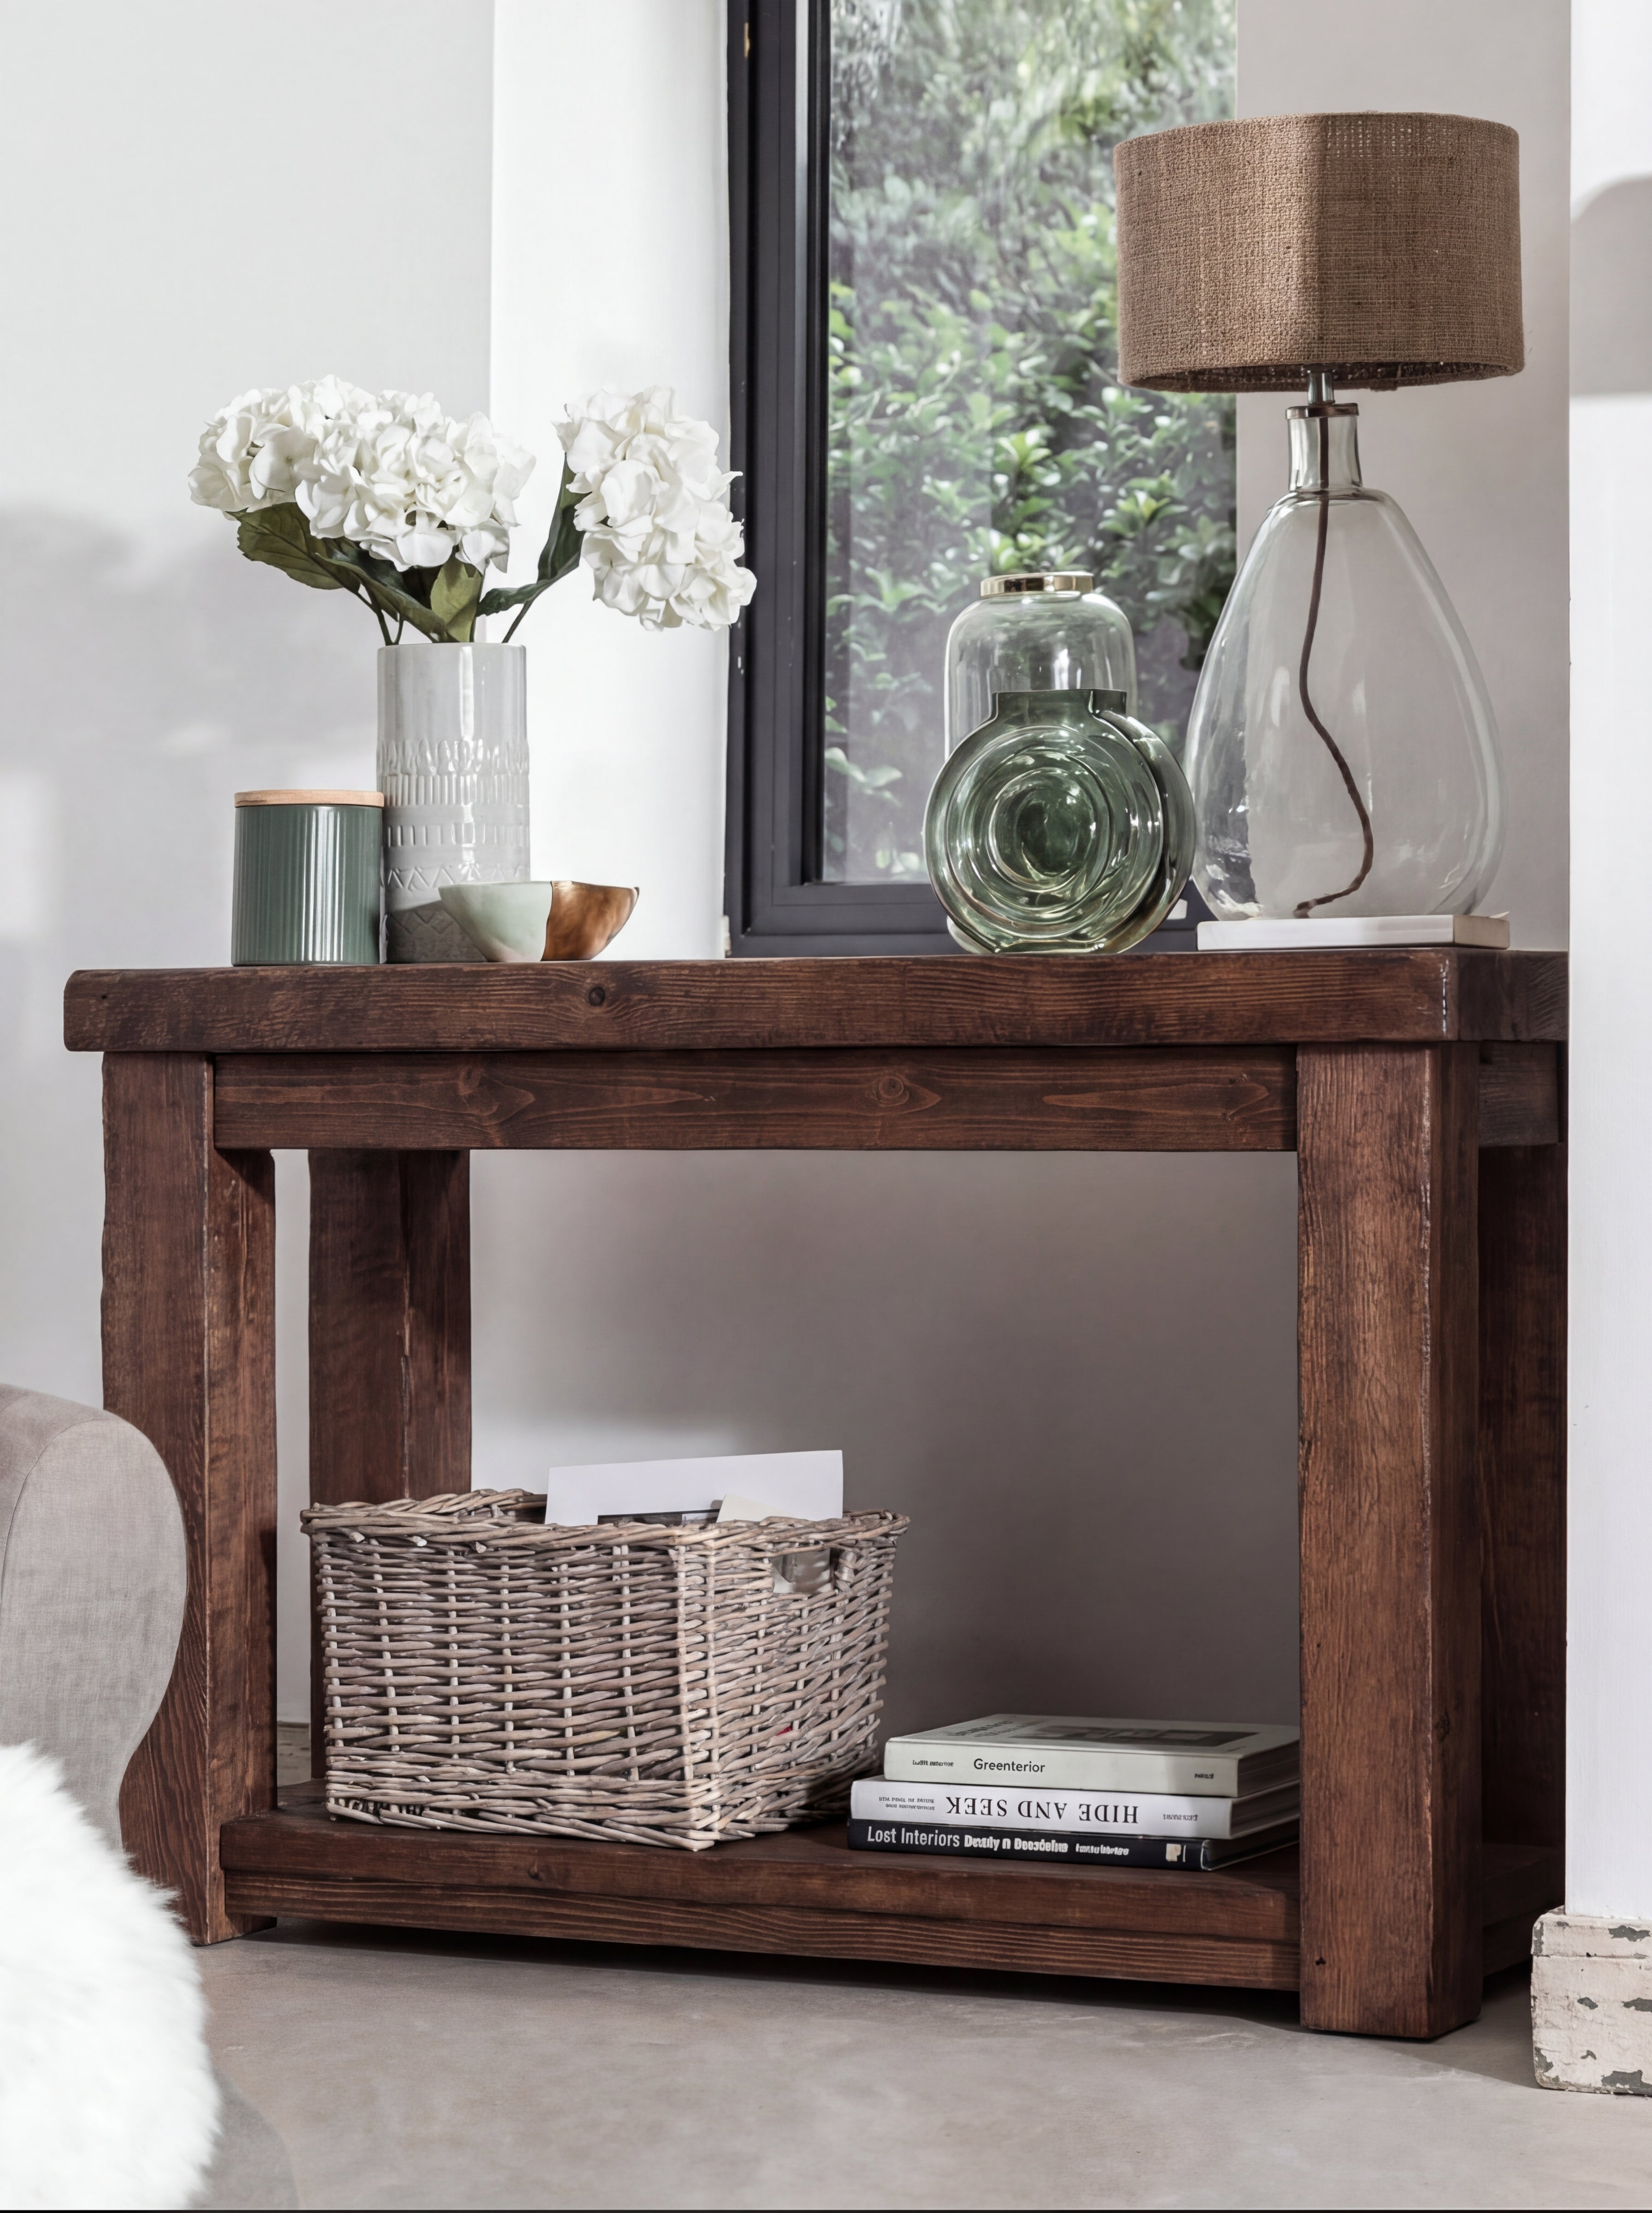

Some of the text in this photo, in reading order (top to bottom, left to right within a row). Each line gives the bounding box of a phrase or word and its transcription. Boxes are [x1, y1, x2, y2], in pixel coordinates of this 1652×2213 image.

[974, 1758, 1045, 1772] Greenterior
[946, 1797, 1138, 1823] HIDE AND SEEK
[867, 1826, 897, 1843] Lost
[901, 1828, 960, 1847] Interiors
